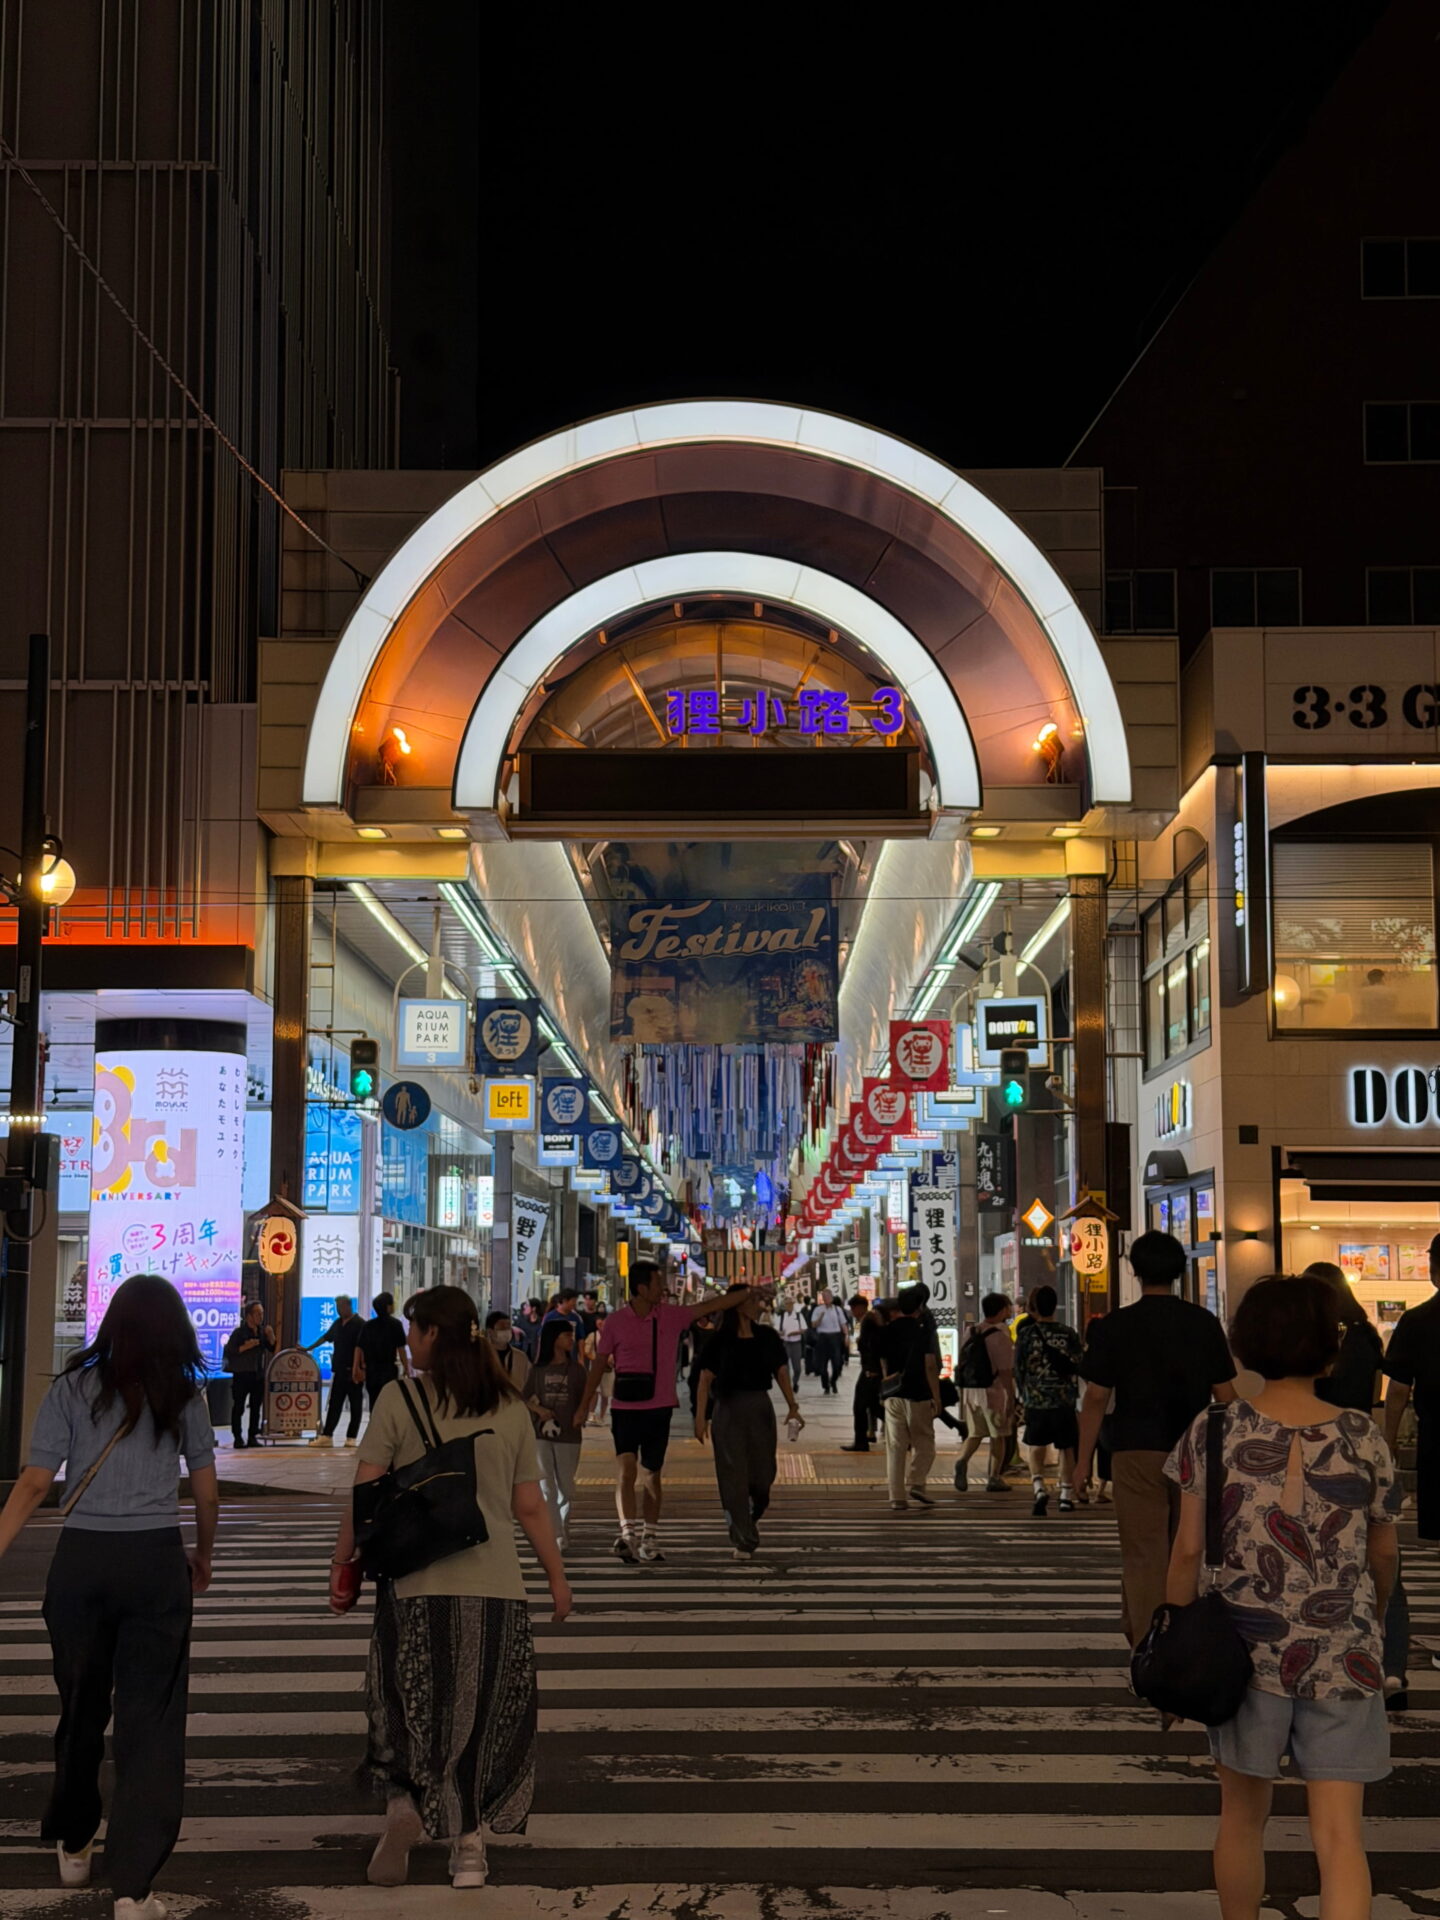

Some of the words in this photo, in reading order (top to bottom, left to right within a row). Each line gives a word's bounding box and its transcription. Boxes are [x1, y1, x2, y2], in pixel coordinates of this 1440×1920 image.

[667, 689, 850, 735] 狸小路
[871, 687, 904, 734] 3
[620, 900, 826, 960] Festival
[417, 1010, 449, 1020] AQUA
[417, 1022, 449, 1031] RIUM
[988, 1020, 1035, 1035] DOUTOR
[416, 1033, 448, 1043] PARK
[427, 1052, 437, 1064] 3
[1352, 1068, 1440, 1125] DO
[309, 1151, 353, 1165] AQUA
[308, 1168, 353, 1181] RIUM
[308, 1184, 352, 1197] PARK
[150, 1218, 219, 1251] 3周年
[1084, 1223, 1105, 1269] 狸小路
[924, 1208, 948, 1302] 狸まつり
